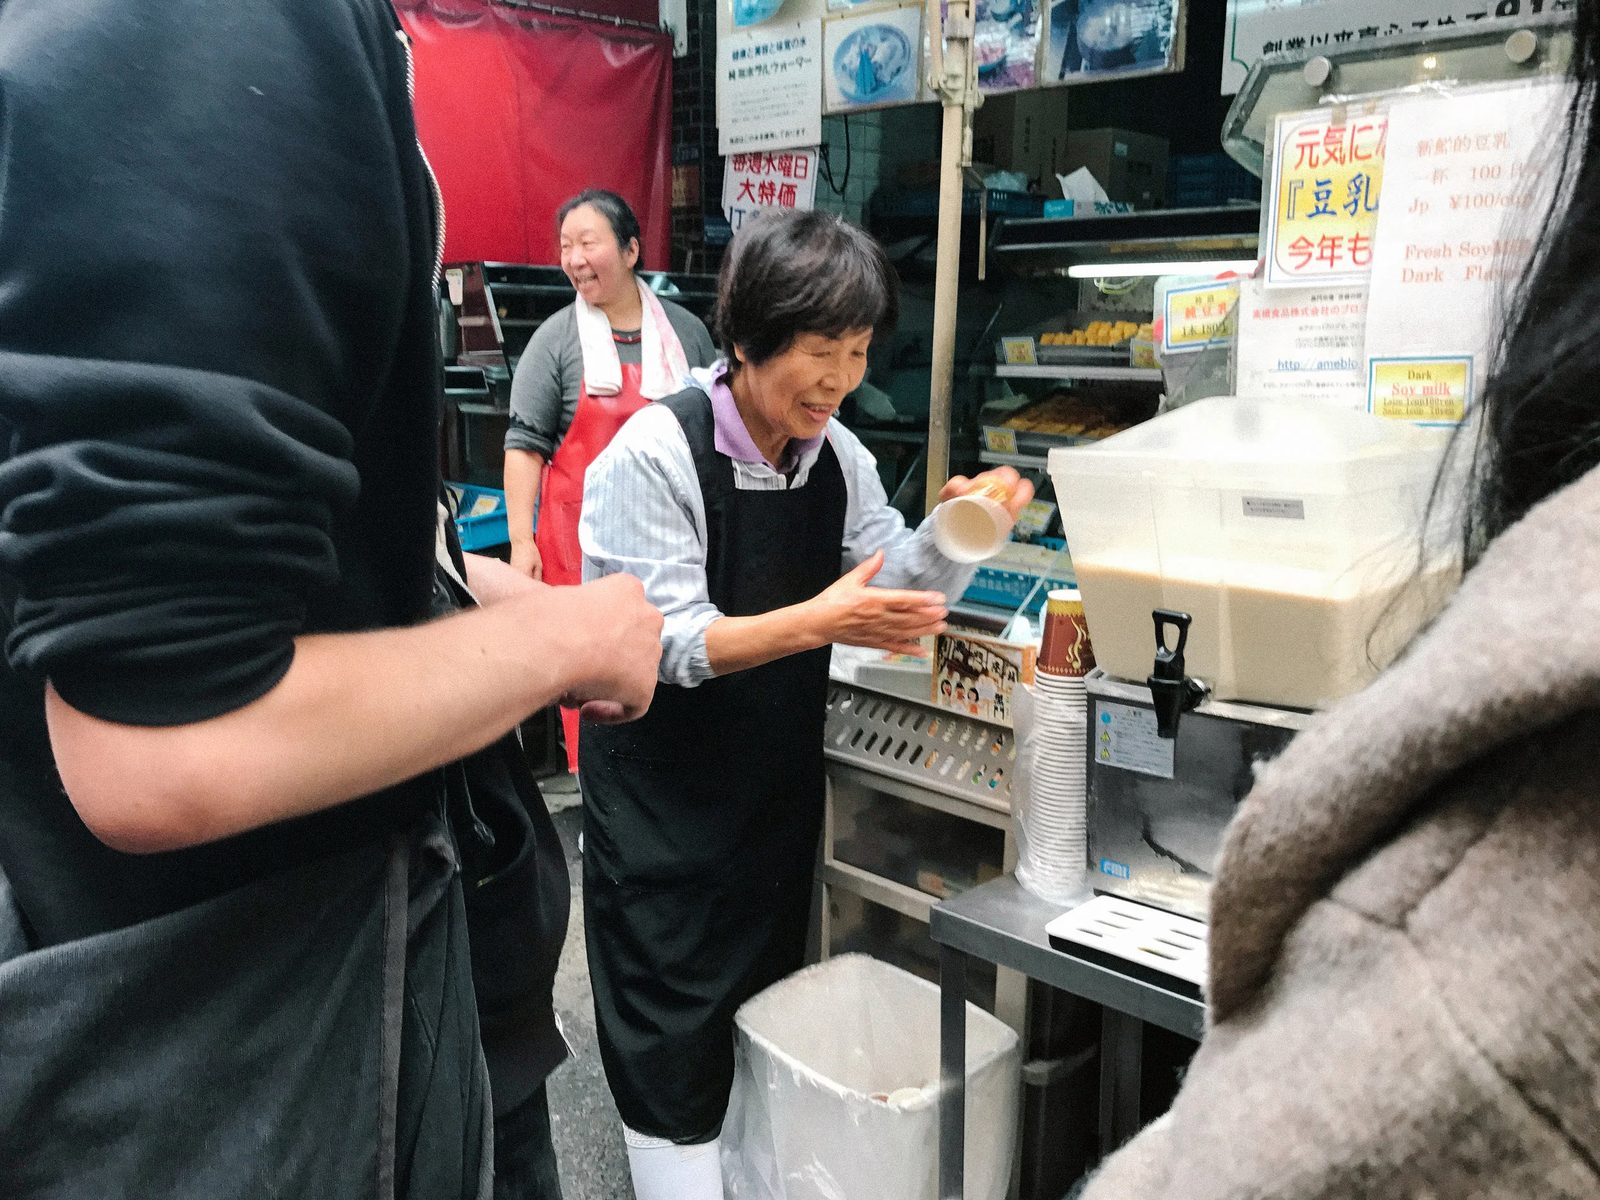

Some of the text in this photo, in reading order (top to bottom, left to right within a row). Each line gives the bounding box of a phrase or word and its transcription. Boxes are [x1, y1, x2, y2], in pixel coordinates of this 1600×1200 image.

[732, 150, 808, 179] 毎週水曜日
[736, 178, 798, 209] 大特価
[1408, 198, 1429, 215] Jp
[1288, 231, 1373, 270] 今年も
[1405, 242, 1452, 259] Fresh
[1402, 267, 1444, 282] Dark
[1407, 370, 1432, 380] Dark
[1391, 382, 1451, 396] Soy milk
